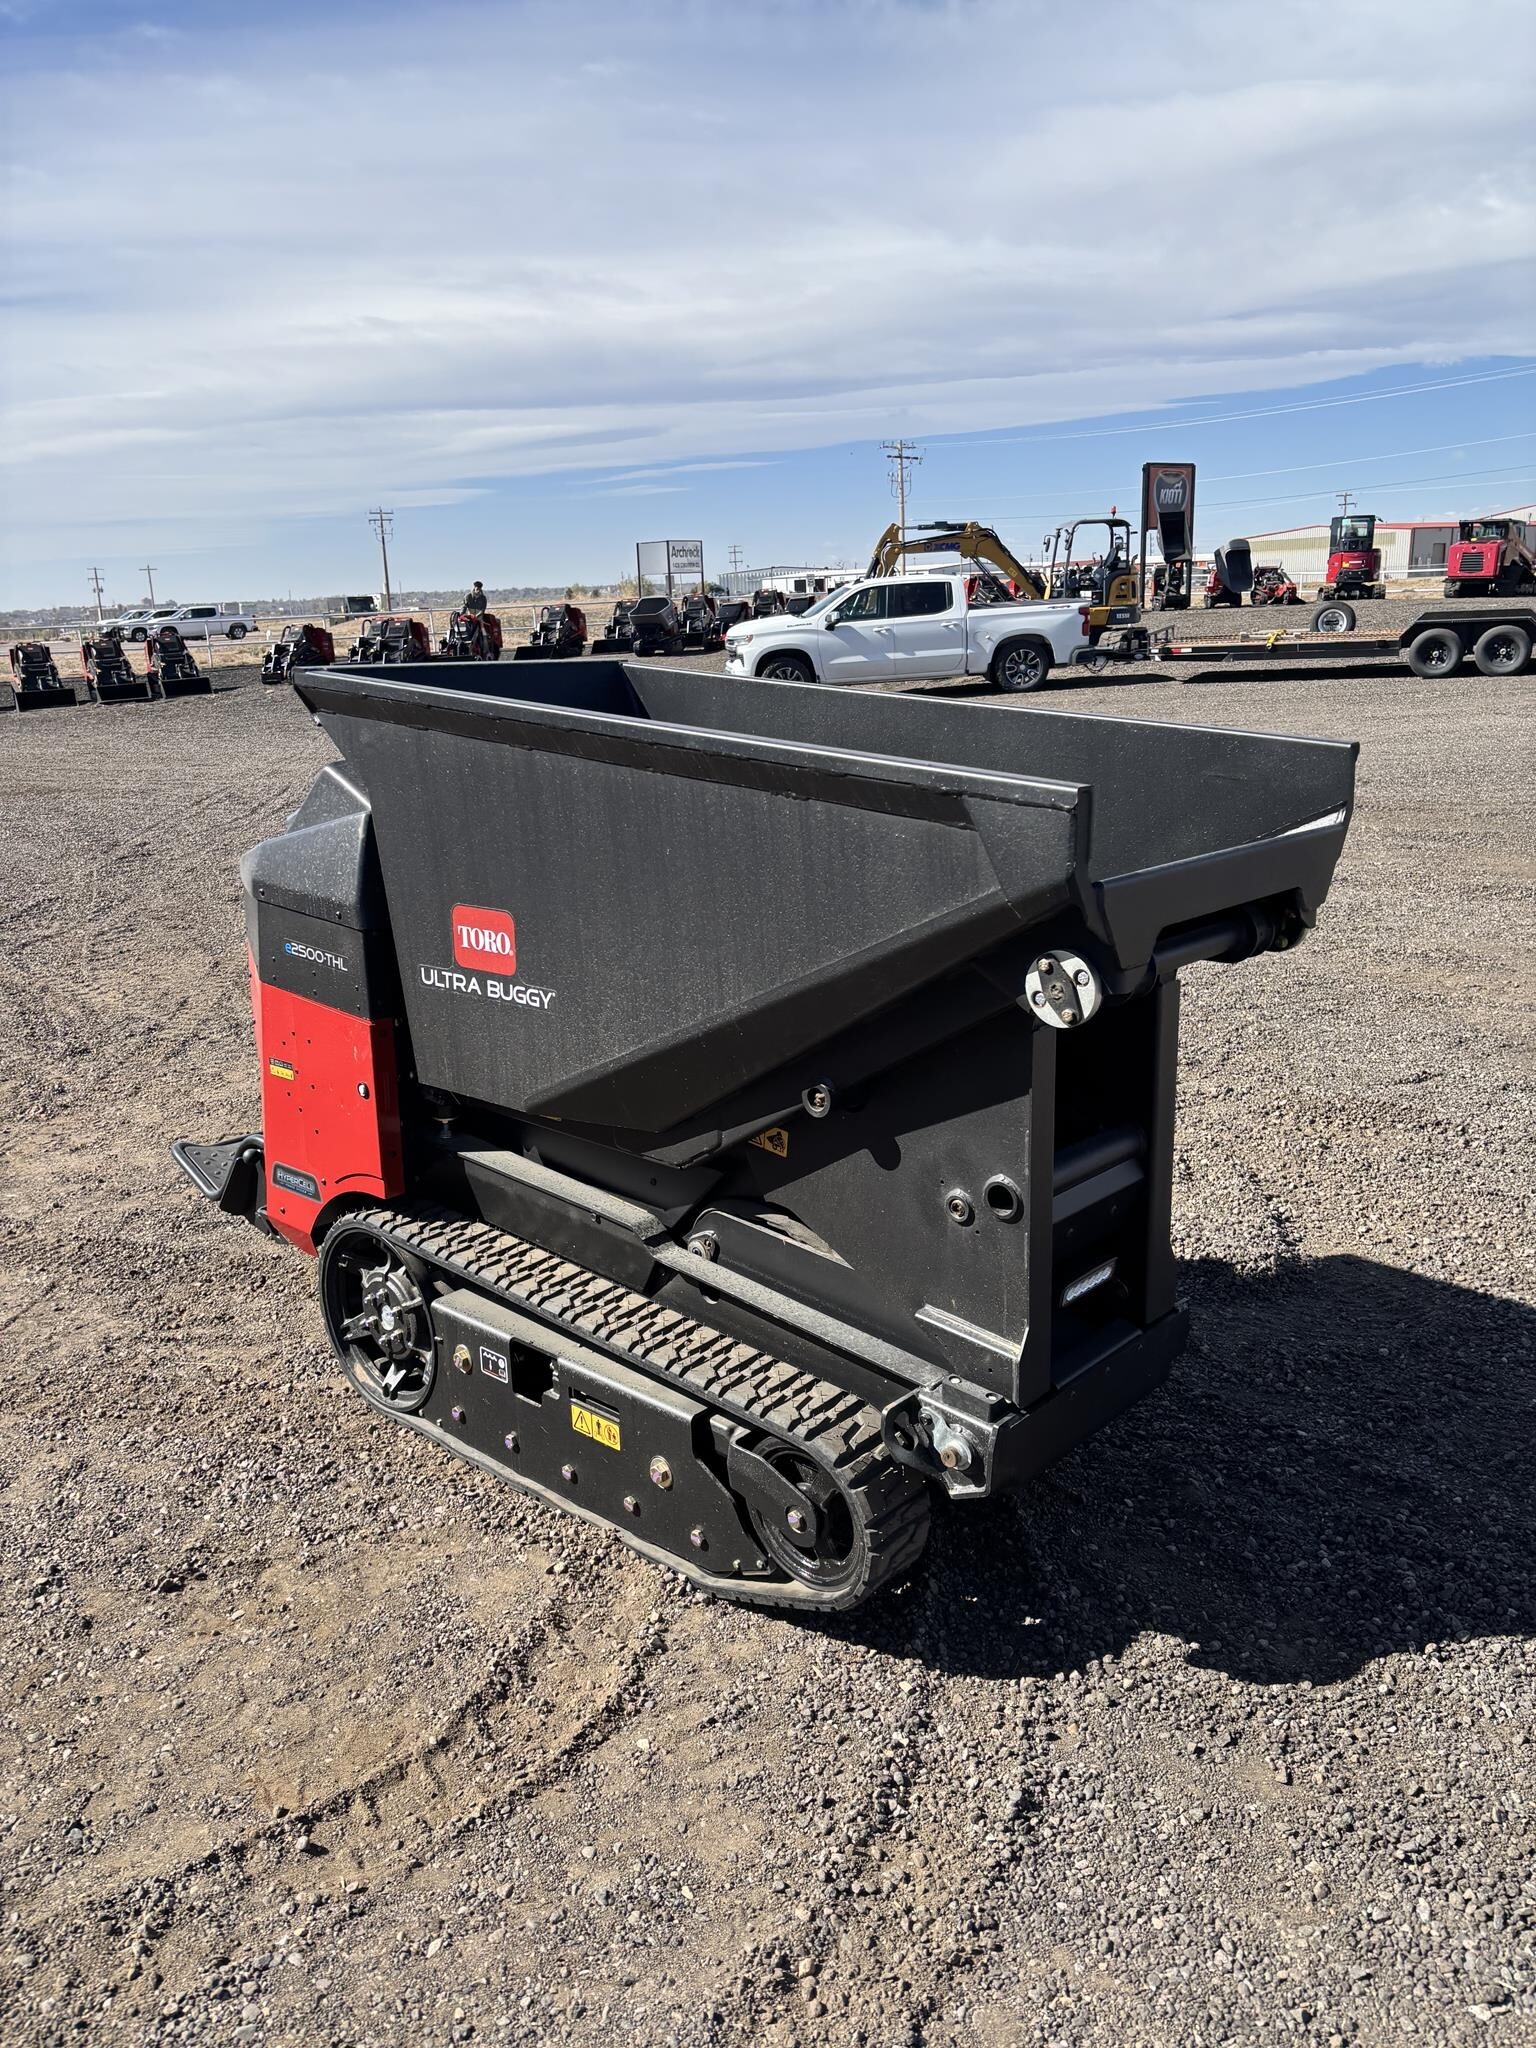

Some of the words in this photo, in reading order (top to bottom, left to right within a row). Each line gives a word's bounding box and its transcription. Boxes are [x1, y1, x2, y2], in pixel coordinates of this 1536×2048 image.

[457, 925, 512, 956] TORO
[420, 967, 482, 996] ULTRA
[486, 979, 555, 1010] BUGGY
